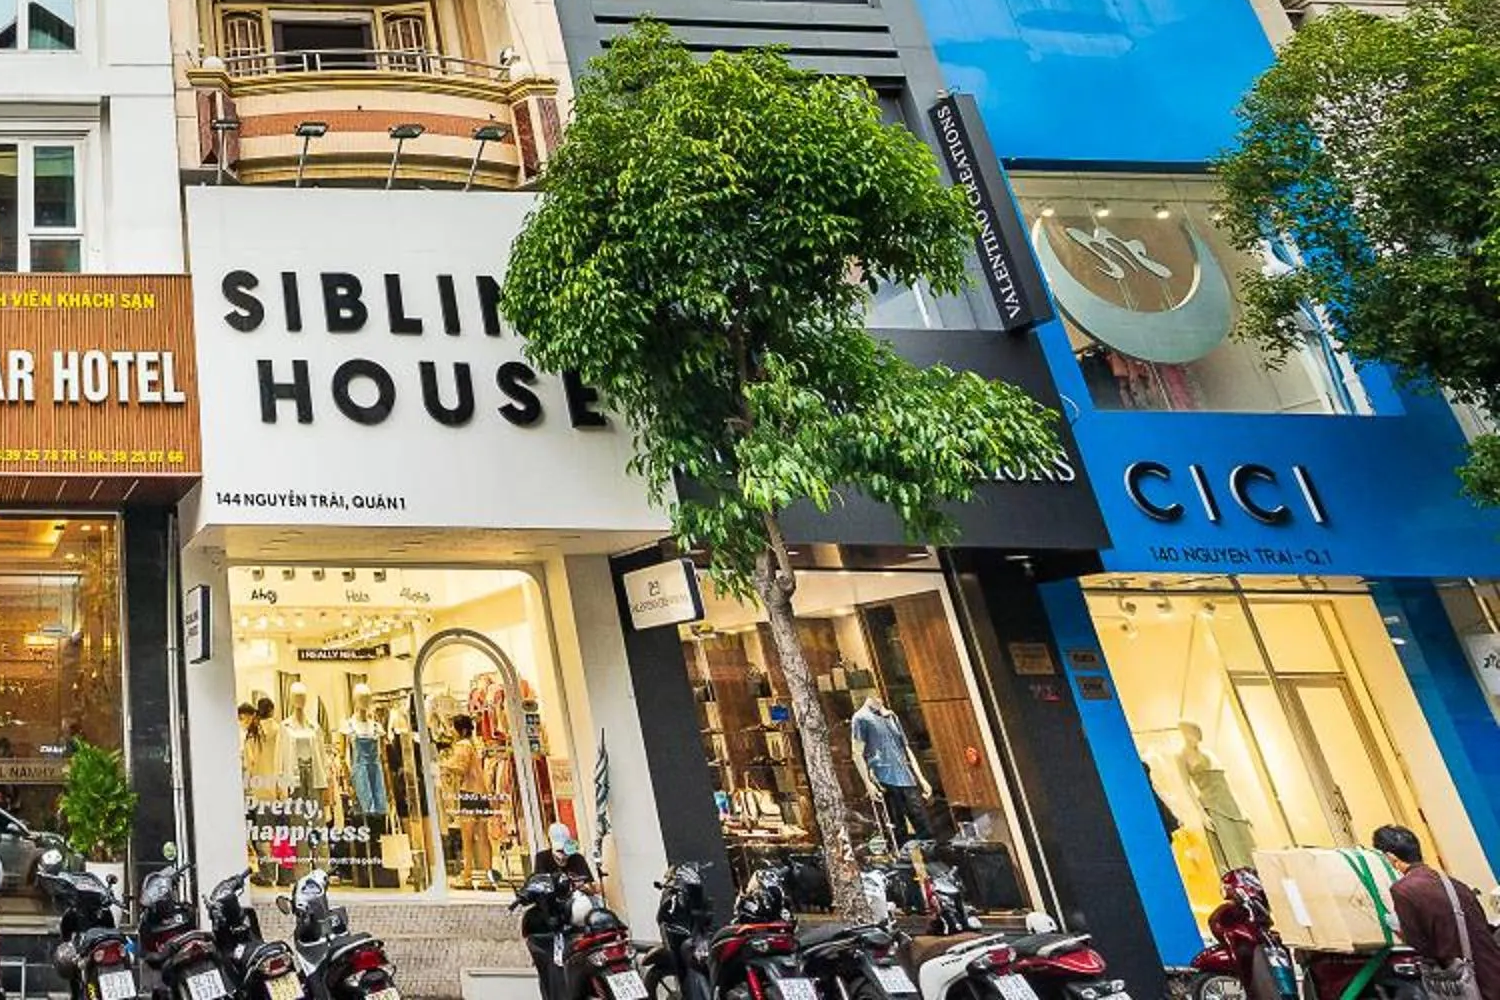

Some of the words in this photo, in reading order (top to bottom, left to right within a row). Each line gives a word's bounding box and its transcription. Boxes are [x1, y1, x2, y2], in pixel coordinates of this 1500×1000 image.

[937, 105, 982, 207] CREATIONS
[975, 209, 1021, 320] VALENTINO
[57, 290, 115, 309] KHÁCH
[121, 293, 155, 310] SẠN
[221, 269, 502, 336] SIBLI
[53, 350, 186, 404] HOTEL
[256, 358, 607, 428] HOUSE
[216, 492, 241, 506] 144
[1124, 461, 1328, 524] CICI
